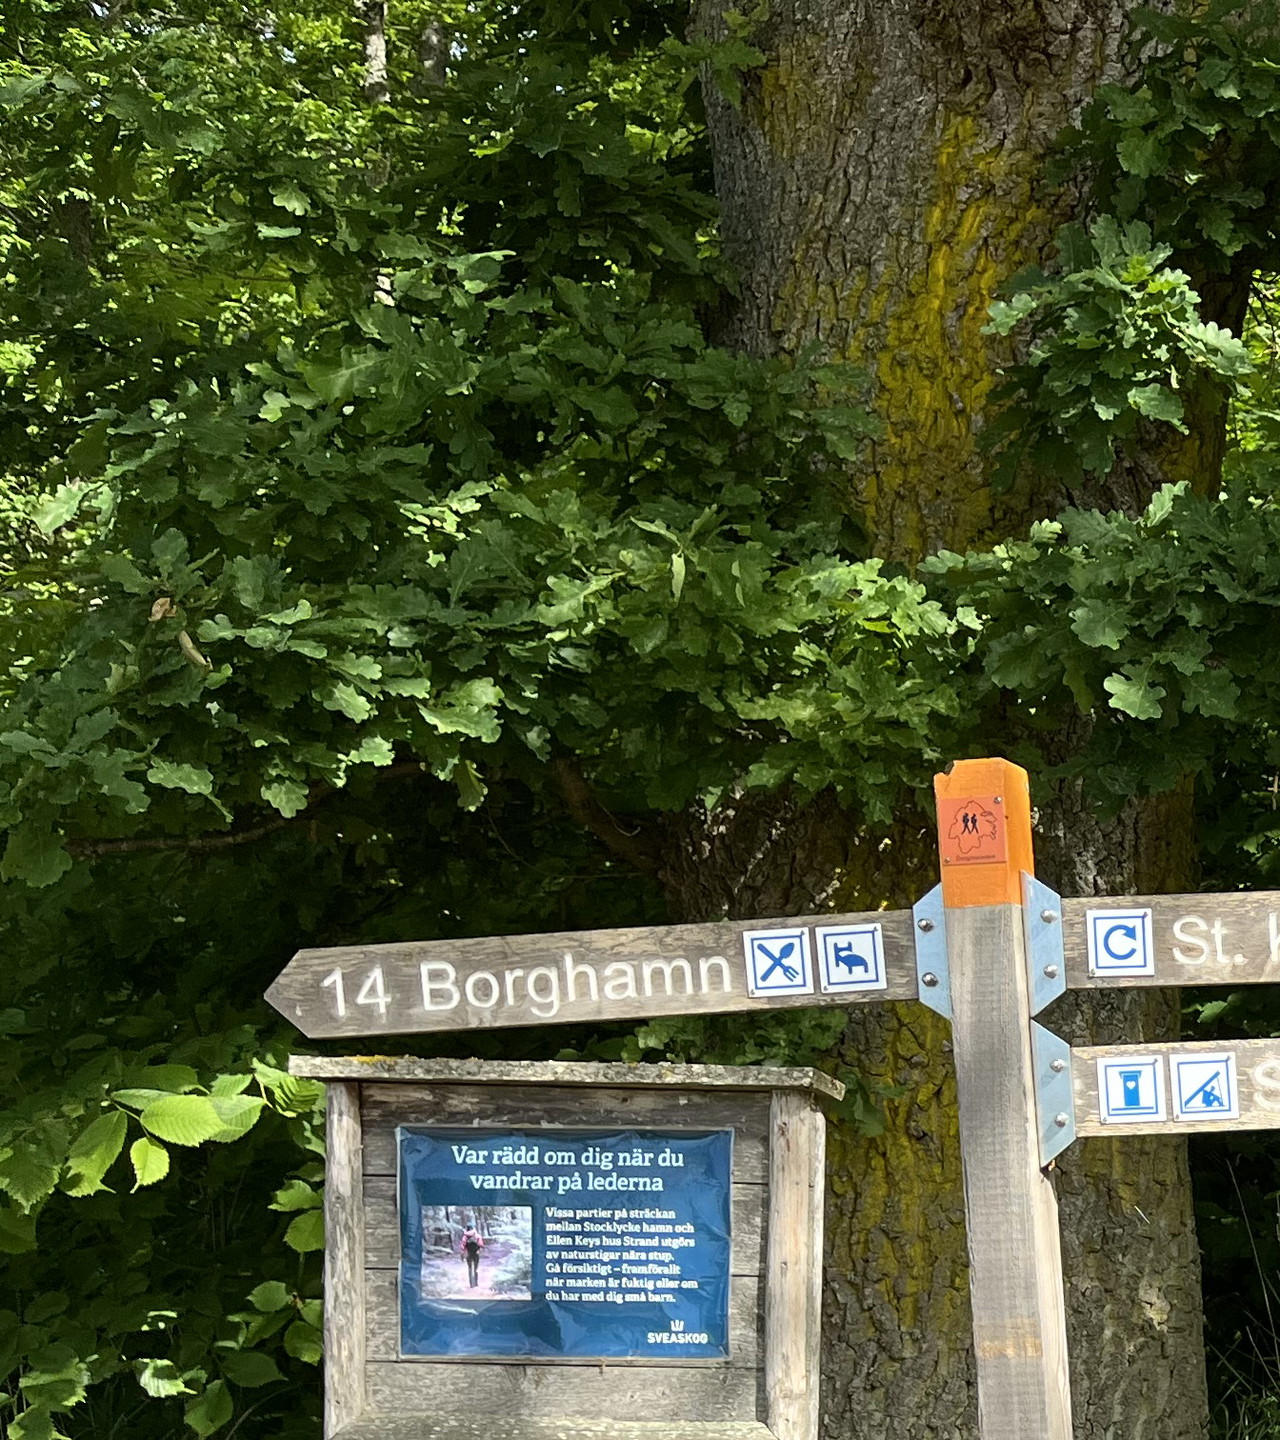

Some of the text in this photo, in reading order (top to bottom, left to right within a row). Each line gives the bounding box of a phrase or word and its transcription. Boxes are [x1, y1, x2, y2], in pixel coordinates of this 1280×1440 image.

[1171, 913, 1246, 966] St.
[320, 951, 733, 1019] 14 Borghamn
[452, 1144, 684, 1171] Var rädd om dig när du
[470, 1171, 664, 1194] vandrar på lederna
[545, 1207, 676, 1220] Vissa partier på sträckan
[545, 1220, 694, 1235] mellan Stocklycke hamn och
[546, 1235, 695, 1249] Ellen Keys hus Strand utgörs
[545, 1250, 674, 1263] av naturstigar nära stup.
[545, 1262, 560, 1273] Gå
[562, 1262, 612, 1276] försiktigt
[622, 1263, 681, 1274] framförallt
[545, 1277, 698, 1290] när marken är fuktig eller om
[545, 1290, 676, 1304] du har med dig små barn.
[647, 1332, 708, 1344] SVEASKOG
